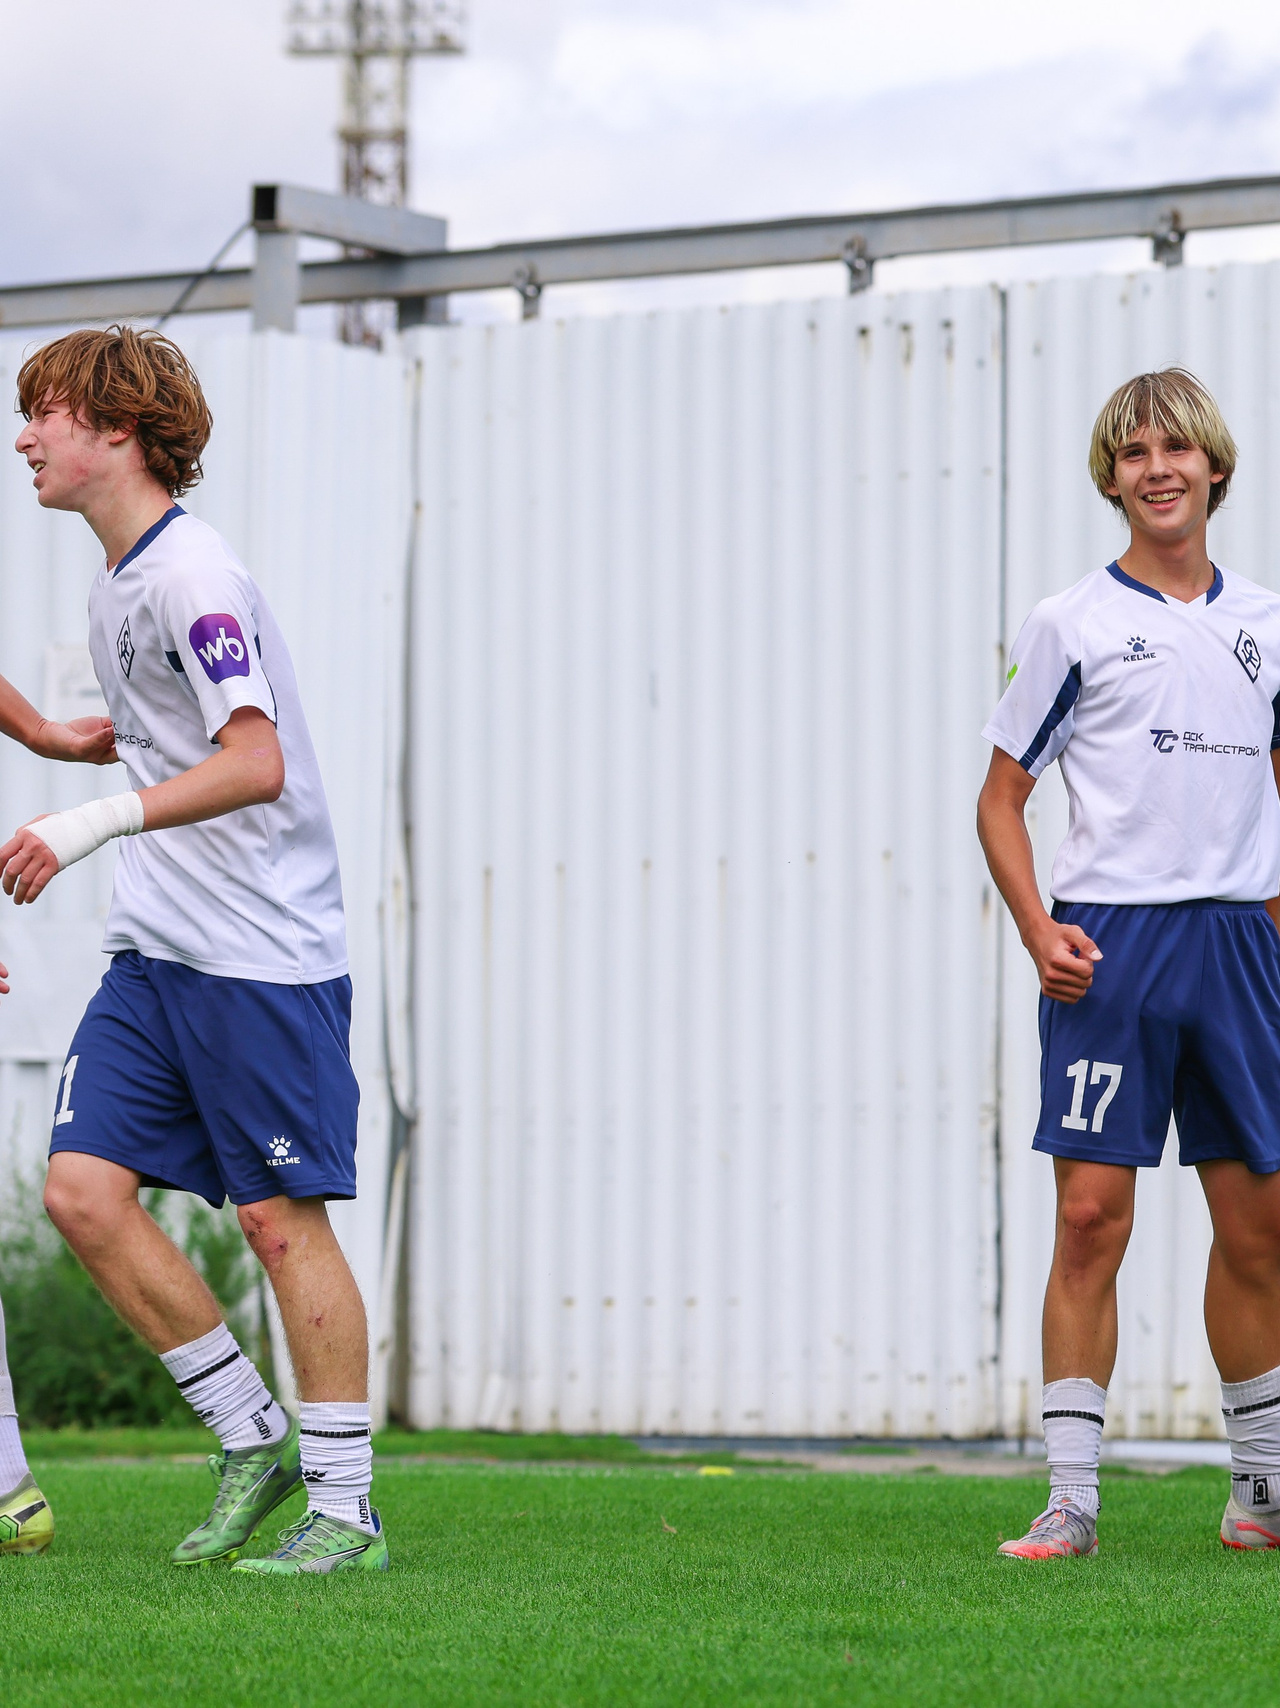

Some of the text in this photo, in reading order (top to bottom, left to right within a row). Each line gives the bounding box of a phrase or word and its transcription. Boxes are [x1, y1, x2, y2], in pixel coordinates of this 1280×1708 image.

[1123, 652, 1157, 662] KELME
[1182, 731, 1204, 742] ДСК
[1182, 742, 1260, 757] ТРАНССТРОЙ
[1061, 1058, 1123, 1133] 17
[265, 1156, 301, 1167] KELME
[250, 1411, 273, 1440] ESIGN
